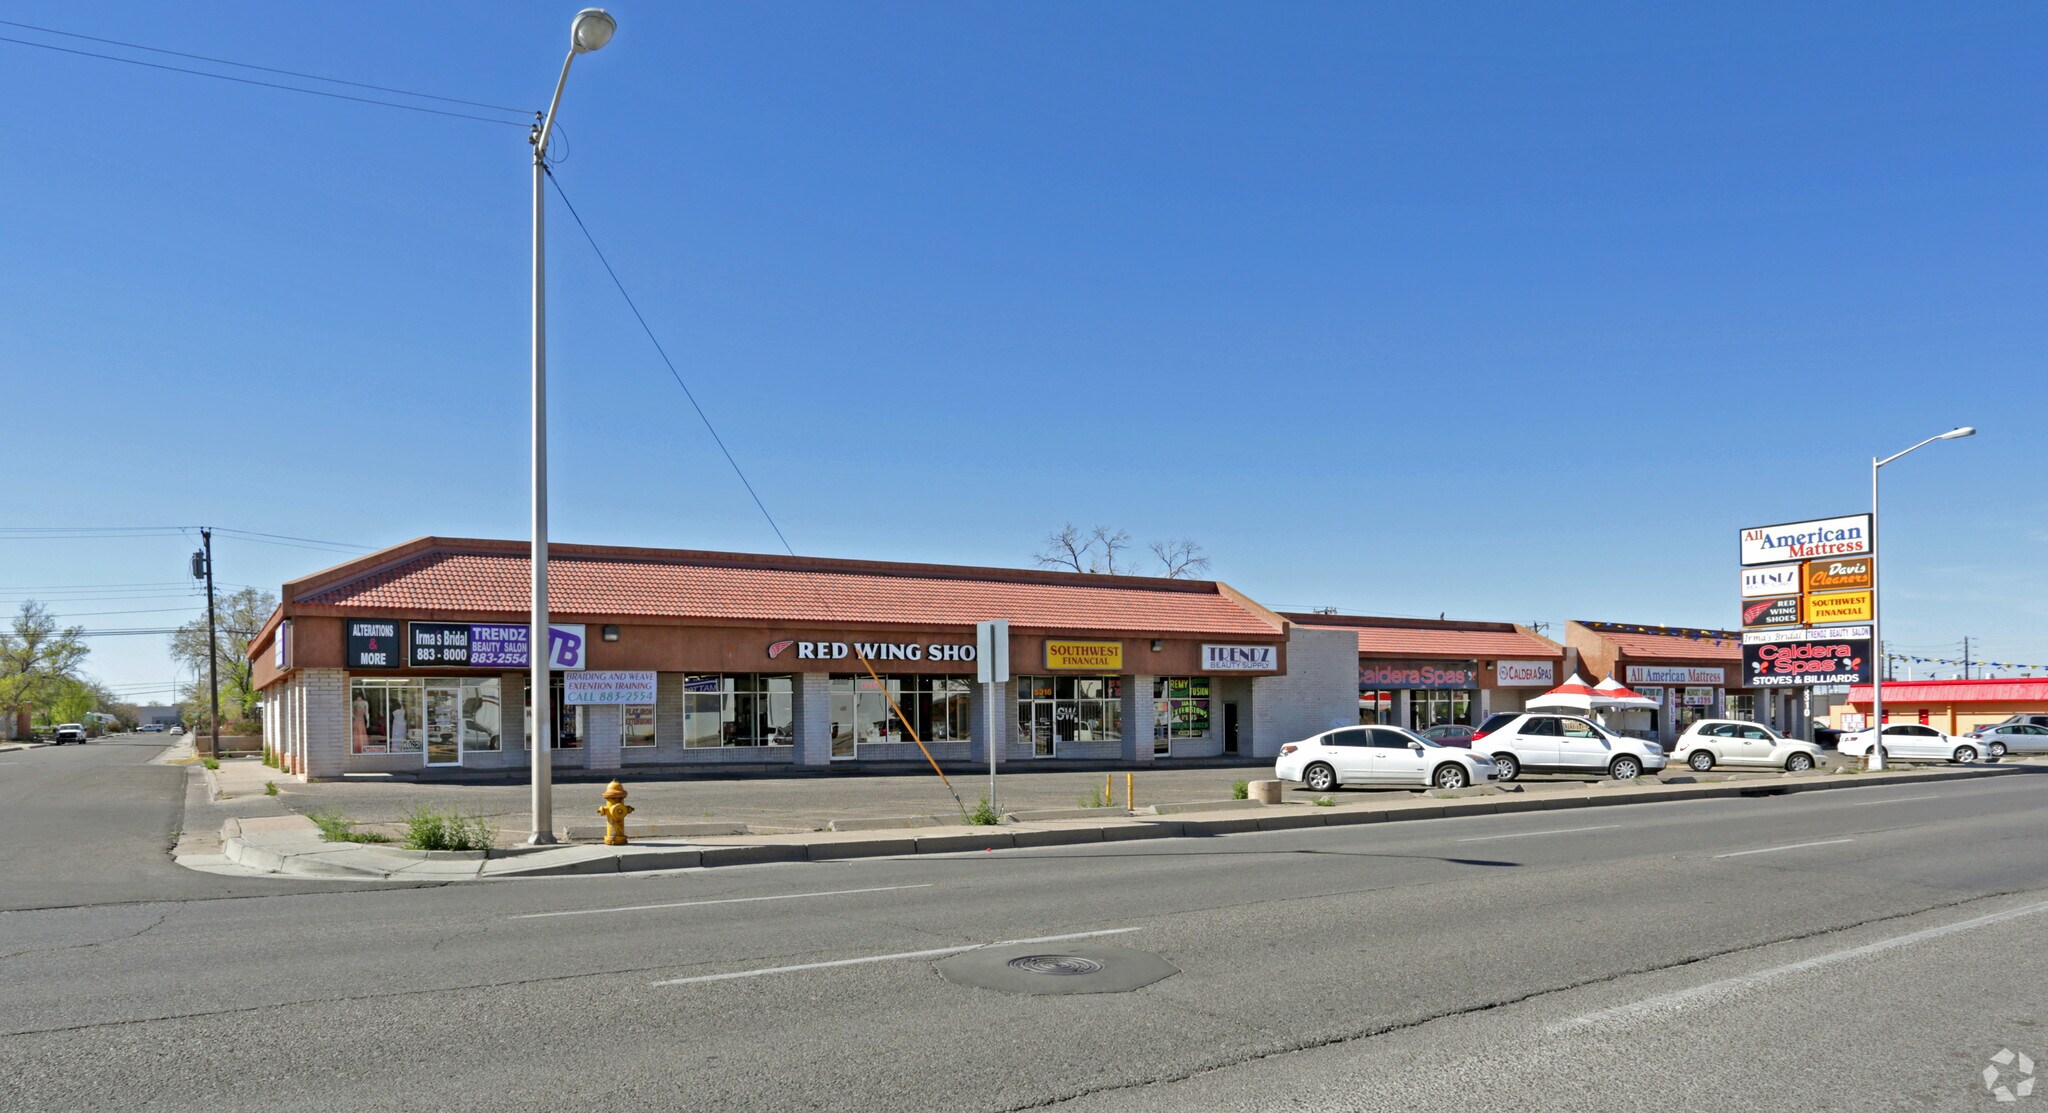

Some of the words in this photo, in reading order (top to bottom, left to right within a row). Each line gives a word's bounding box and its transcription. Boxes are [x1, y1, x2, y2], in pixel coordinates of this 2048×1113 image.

[1744, 529, 1763, 542] All
[1760, 526, 1862, 549] American
[1788, 540, 1863, 558] Mattress
[1829, 563, 1866, 576] Davis
[1810, 571, 1868, 586] Cleaners
[1812, 596, 1866, 606] SOUTHWEST
[1770, 607, 1796, 615] WING
[1816, 607, 1864, 617] FINANCIAL
[1766, 614, 1797, 623] SHOES
[352, 624, 394, 637] ALTERATIONS
[472, 627, 527, 641] TRENDZ
[1775, 632, 1802, 641] Bridal
[1829, 628, 1850, 638] BEAUTY
[1851, 627, 1869, 637] SALON
[368, 638, 378, 650] &
[443, 630, 468, 646] Bridal
[472, 641, 501, 653] BEAUTY
[504, 642, 527, 653] SALON
[797, 641, 848, 659] RED
[854, 642, 922, 661] WING
[928, 644, 977, 661] SHO
[1050, 645, 1120, 657] SOUTHWEST
[1758, 643, 1851, 660] Caldera
[360, 652, 387, 665] MORE
[416, 648, 435, 660] 883
[443, 648, 467, 661] 8000
[470, 653, 527, 664] 883-2554
[1208, 647, 1270, 662] TRENDZ
[1062, 657, 1109, 665] FINANCIAL
[1774, 658, 1836, 676] Spas
[566, 672, 607, 680] BRAIDING
[608, 672, 627, 680] AND
[629, 672, 654, 680] WEAVE
[1421, 666, 1466, 687] Spas
[1631, 668, 1643, 682] All
[1645, 668, 1686, 682] American
[1688, 669, 1721, 682] Mattress
[1752, 675, 1793, 685] STOVES
[1794, 675, 1803, 684] &
[1805, 674, 1860, 684] BILLIARDS
[568, 682, 612, 690] EXTENTION
[615, 682, 652, 690] TRAINING
[1170, 679, 1189, 689] REMY
[567, 692, 596, 701] CALL
[598, 691, 653, 701] 883-2554
